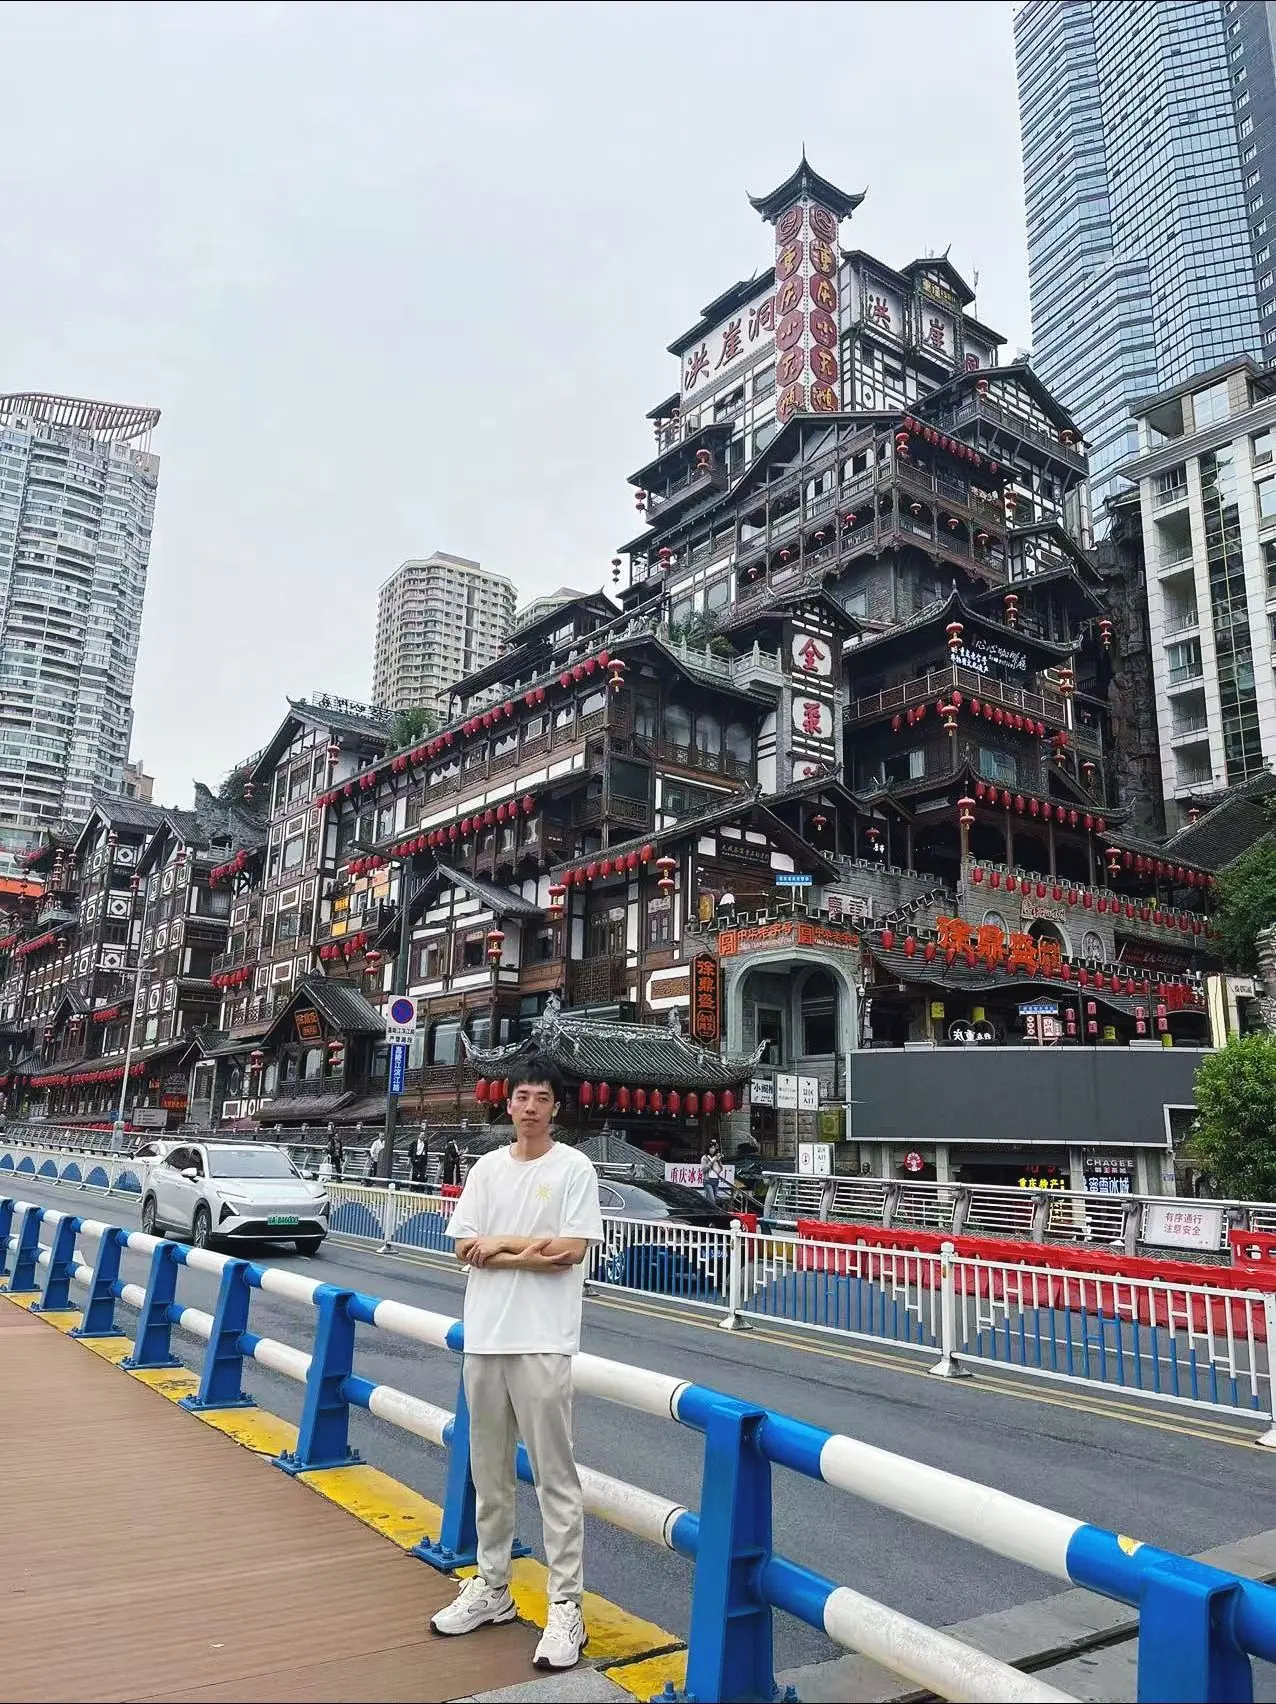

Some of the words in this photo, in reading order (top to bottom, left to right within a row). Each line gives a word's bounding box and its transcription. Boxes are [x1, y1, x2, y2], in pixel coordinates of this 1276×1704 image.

[684, 297, 775, 391] 洪崖洞
[737, 920, 794, 940] 中华老字号
[1086, 1158, 1133, 1167] CHAGEE
[1165, 1212, 1203, 1225] 有序通行
[1163, 1223, 1201, 1236] 注意安全
